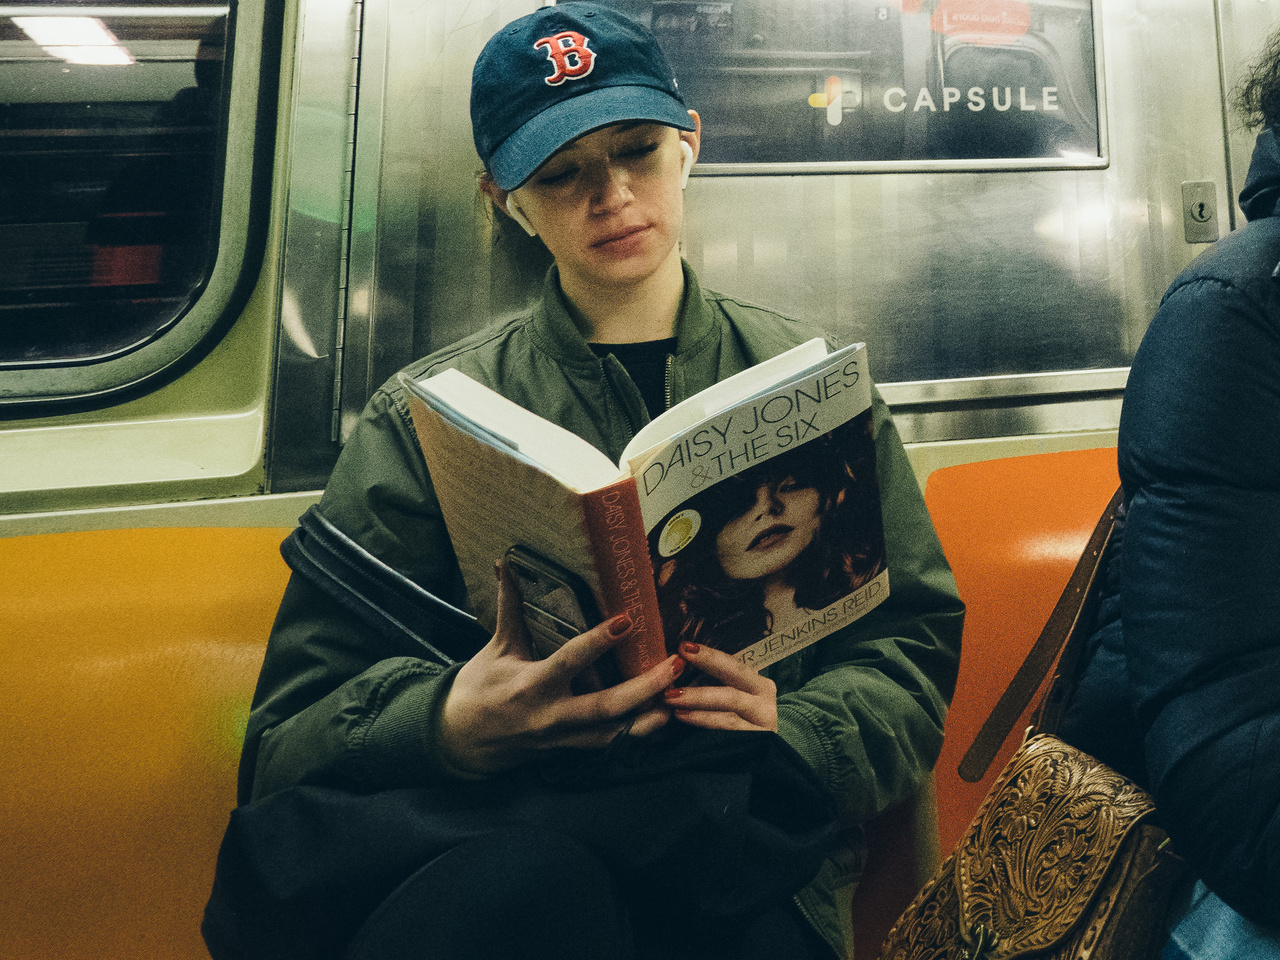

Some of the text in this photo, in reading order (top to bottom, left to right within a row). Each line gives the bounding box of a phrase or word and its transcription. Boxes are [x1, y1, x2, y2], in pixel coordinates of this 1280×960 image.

[533, 31, 597, 87] B
[883, 87, 1059, 112] CAPSULE
[642, 360, 860, 496] DAISY JONES
[691, 412, 820, 488] & THE SIX
[601, 491, 627, 530] DAISY
[610, 535, 635, 579] JONES
[620, 579, 638, 593] &
[623, 590, 644, 615] THE
[759, 607, 838, 657] JENKINS
[843, 581, 881, 614] REID
